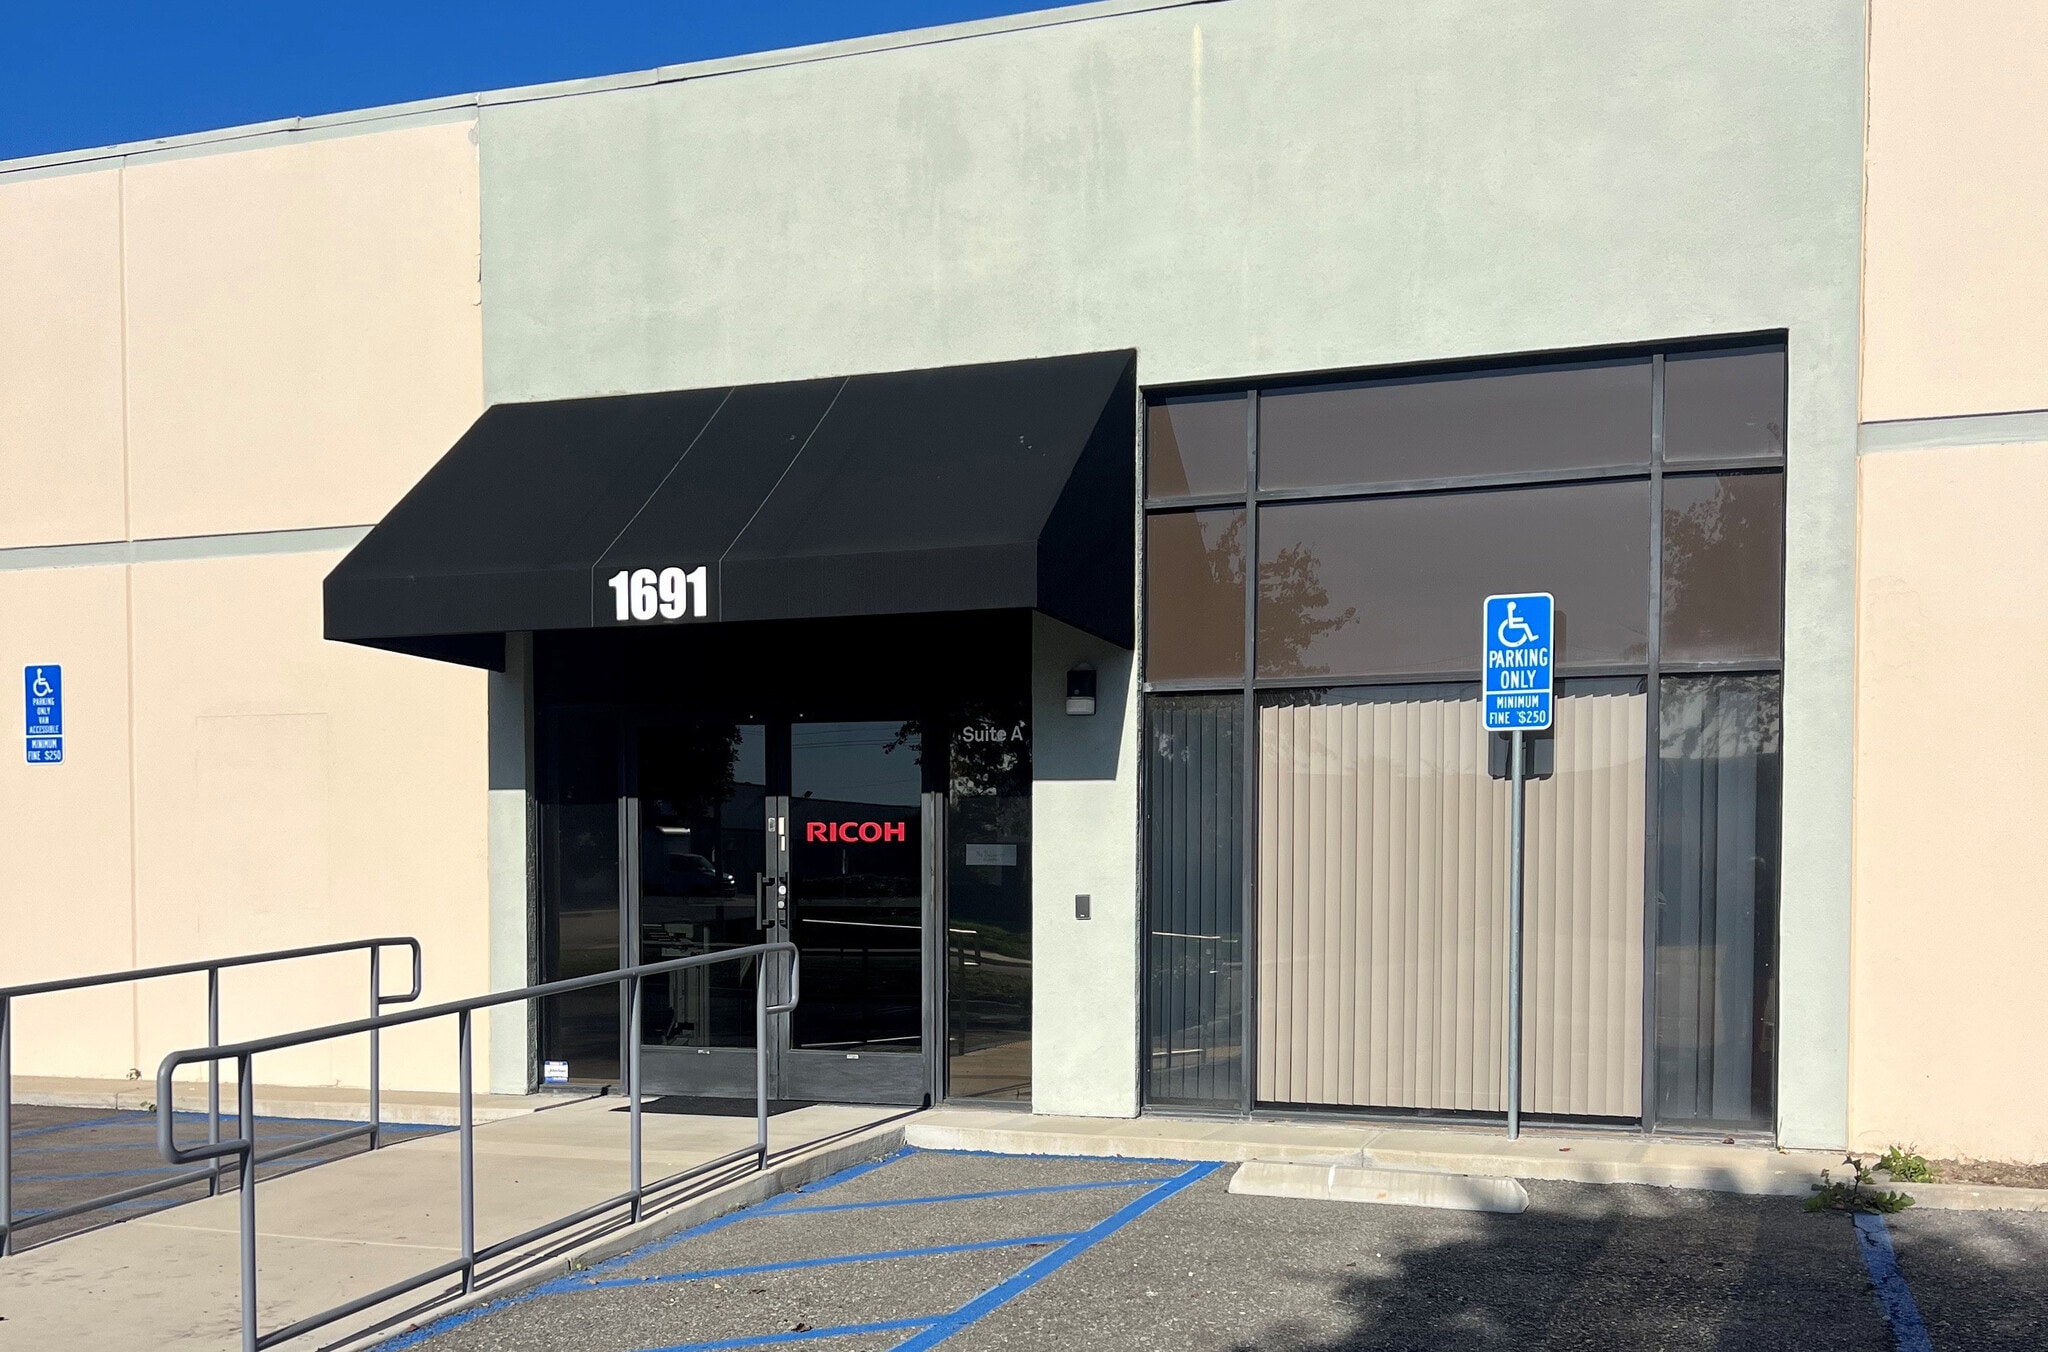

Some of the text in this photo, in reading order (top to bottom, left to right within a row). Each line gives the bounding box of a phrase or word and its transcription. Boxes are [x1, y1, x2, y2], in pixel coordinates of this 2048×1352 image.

[608, 566, 707, 621] 1691
[1489, 647, 1548, 669] PARKING
[1500, 670, 1537, 690] ONLY
[32, 697, 55, 706] PARKING
[1496, 695, 1539, 709] MINIMUM
[36, 706, 51, 716] ONLY
[1489, 710, 1546, 725] FINE $250
[38, 716, 50, 725] VAN
[29, 724, 59, 734] ACCESSIBLE
[962, 725, 1023, 742] Suite A
[31, 739, 57, 749] MINIMUM
[27, 750, 61, 761] FINE $250
[806, 821, 905, 842] RICOH
